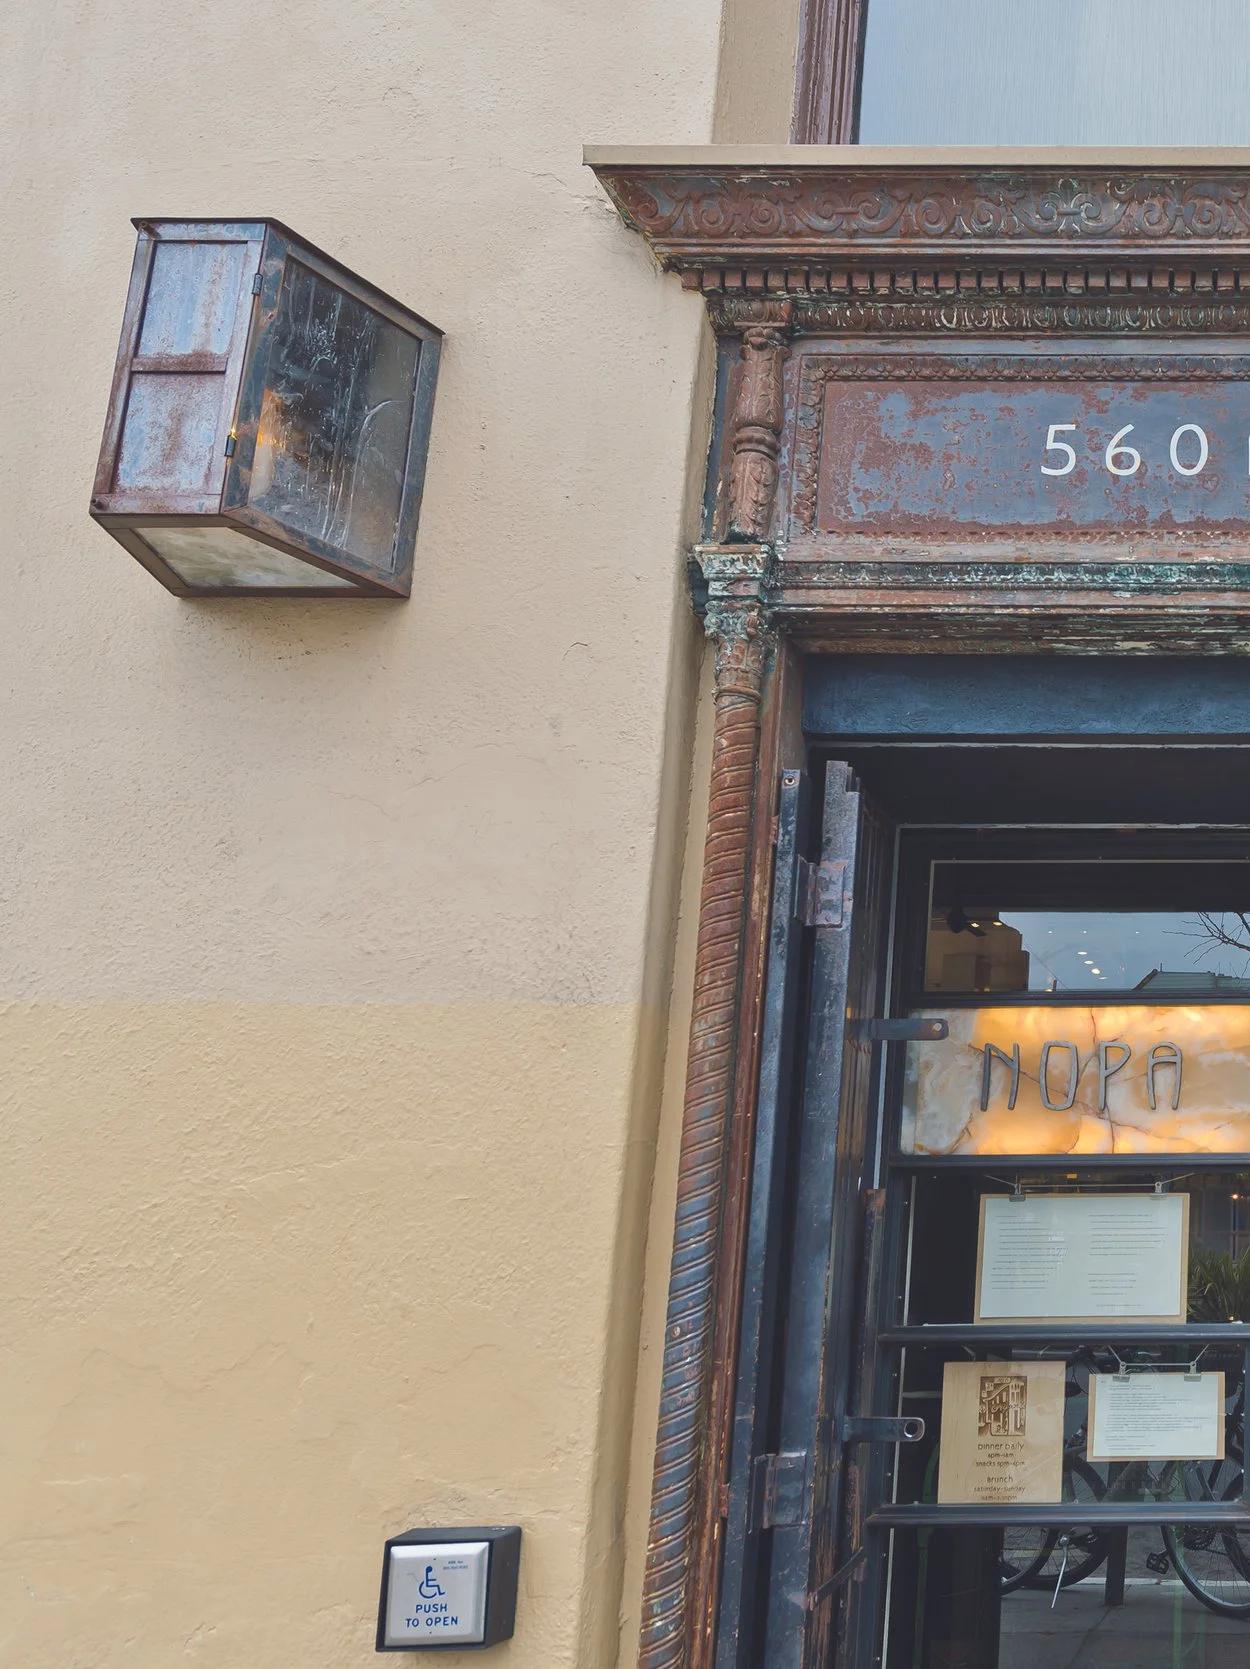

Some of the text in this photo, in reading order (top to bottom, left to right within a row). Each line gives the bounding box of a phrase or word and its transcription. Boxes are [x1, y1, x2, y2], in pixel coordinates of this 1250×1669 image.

[1040, 423, 1210, 477] 560
[980, 1040, 1183, 1112] NOPA
[405, 1616, 459, 1628] TO OPEN
[415, 1603, 448, 1613] PUSH
